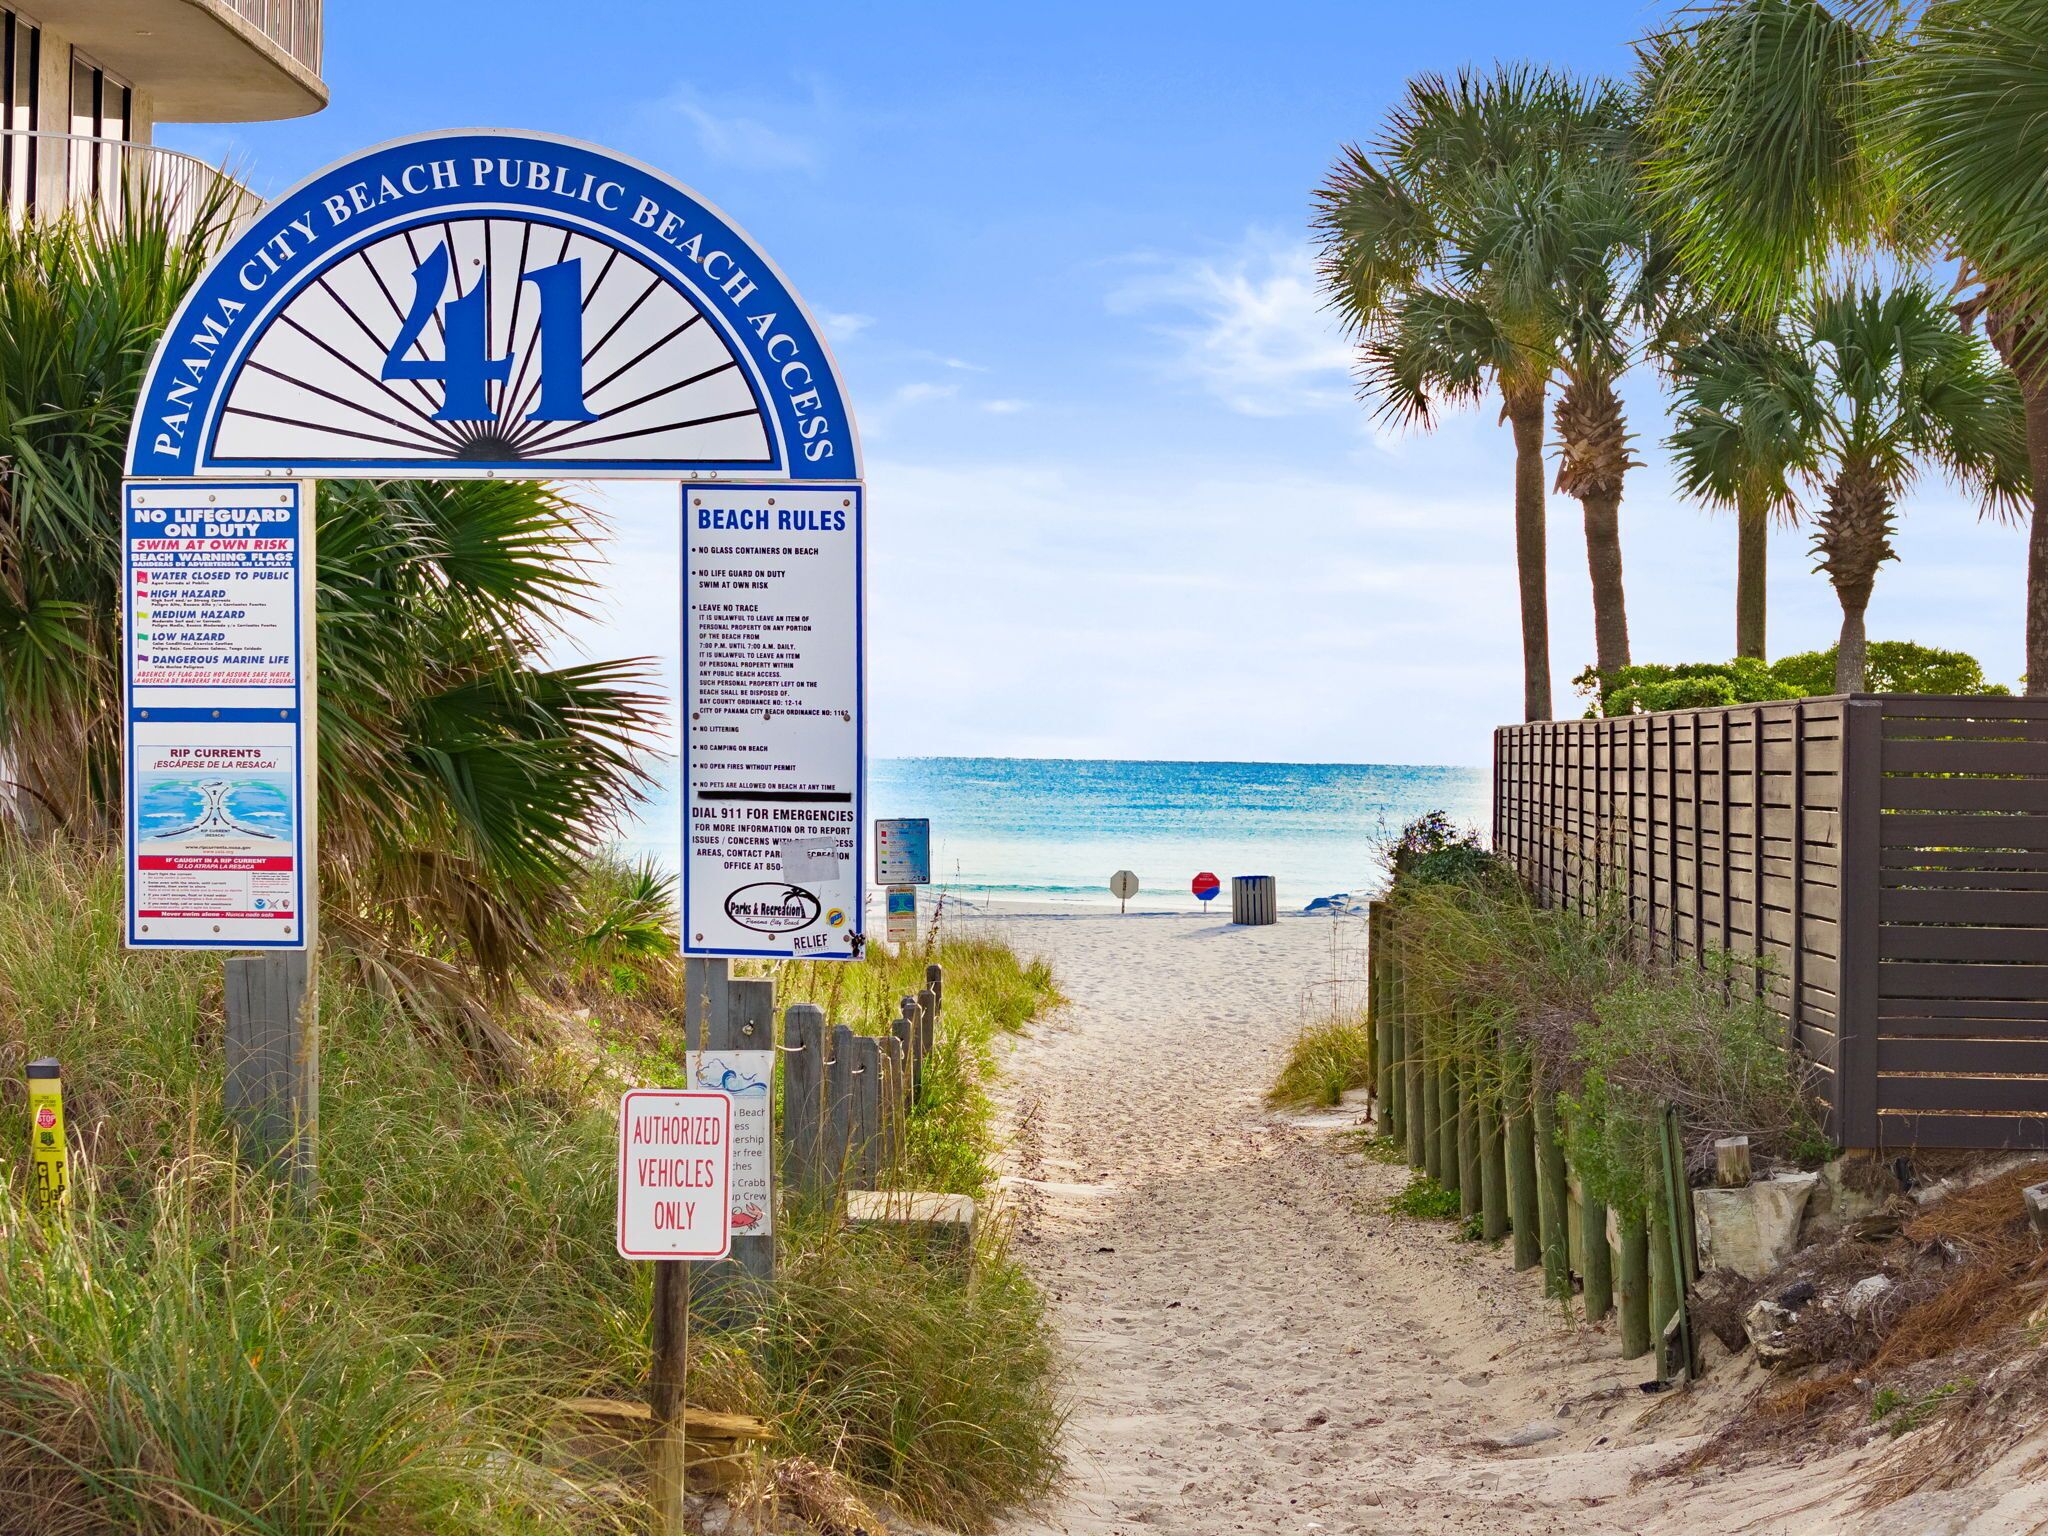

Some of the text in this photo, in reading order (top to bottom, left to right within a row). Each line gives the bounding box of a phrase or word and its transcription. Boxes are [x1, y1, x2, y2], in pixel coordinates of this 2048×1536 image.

[153, 158, 834, 462] PANAMA CITY BEACH PUBLIC BEACH ACCESS
[381, 240, 601, 421] 41
[135, 510, 290, 522] NO LIFEGUARD
[699, 510, 845, 531] BEACH RULES
[165, 524, 260, 536] ON DUTY
[137, 540, 288, 550] SWIM AT OWN RISK
[736, 547, 780, 555] CONTAINERS
[252, 553, 293, 561] FLAGS
[151, 572, 289, 580] WATER CLOSED TO PUBLIC
[150, 590, 226, 598] HIGH HAZARD
[223, 656, 265, 664] MARINE
[269, 656, 289, 664] LIFE
[171, 749, 190, 757] RIP
[153, 759, 205, 769] ¡ESCÁPESE
[692, 808, 854, 822] DIAL 911 FOR EMERGENCIES
[713, 824, 735, 832] MORE
[738, 825, 791, 833] INFORMATION
[820, 827, 850, 835] REPORT
[692, 836, 720, 844] ISSUES
[727, 836, 769, 845] CONCERNS
[697, 849, 762, 858] AREAS, CONTACT
[724, 861, 751, 870] OFFICE
[731, 902, 801, 917] Parks & Recreation
[770, 918, 782, 926] City
[784, 918, 800, 926] Beach
[794, 933, 828, 950] RELIEF
[39, 1114, 56, 1123] STOP
[634, 1117, 720, 1145] AUTHORIZED
[744, 1149, 762, 1158] free
[639, 1159, 713, 1187] VEHICLES
[738, 1178, 766, 1188] Crabb
[743, 1192, 767, 1201] Crew
[655, 1202, 695, 1230] ONLY
